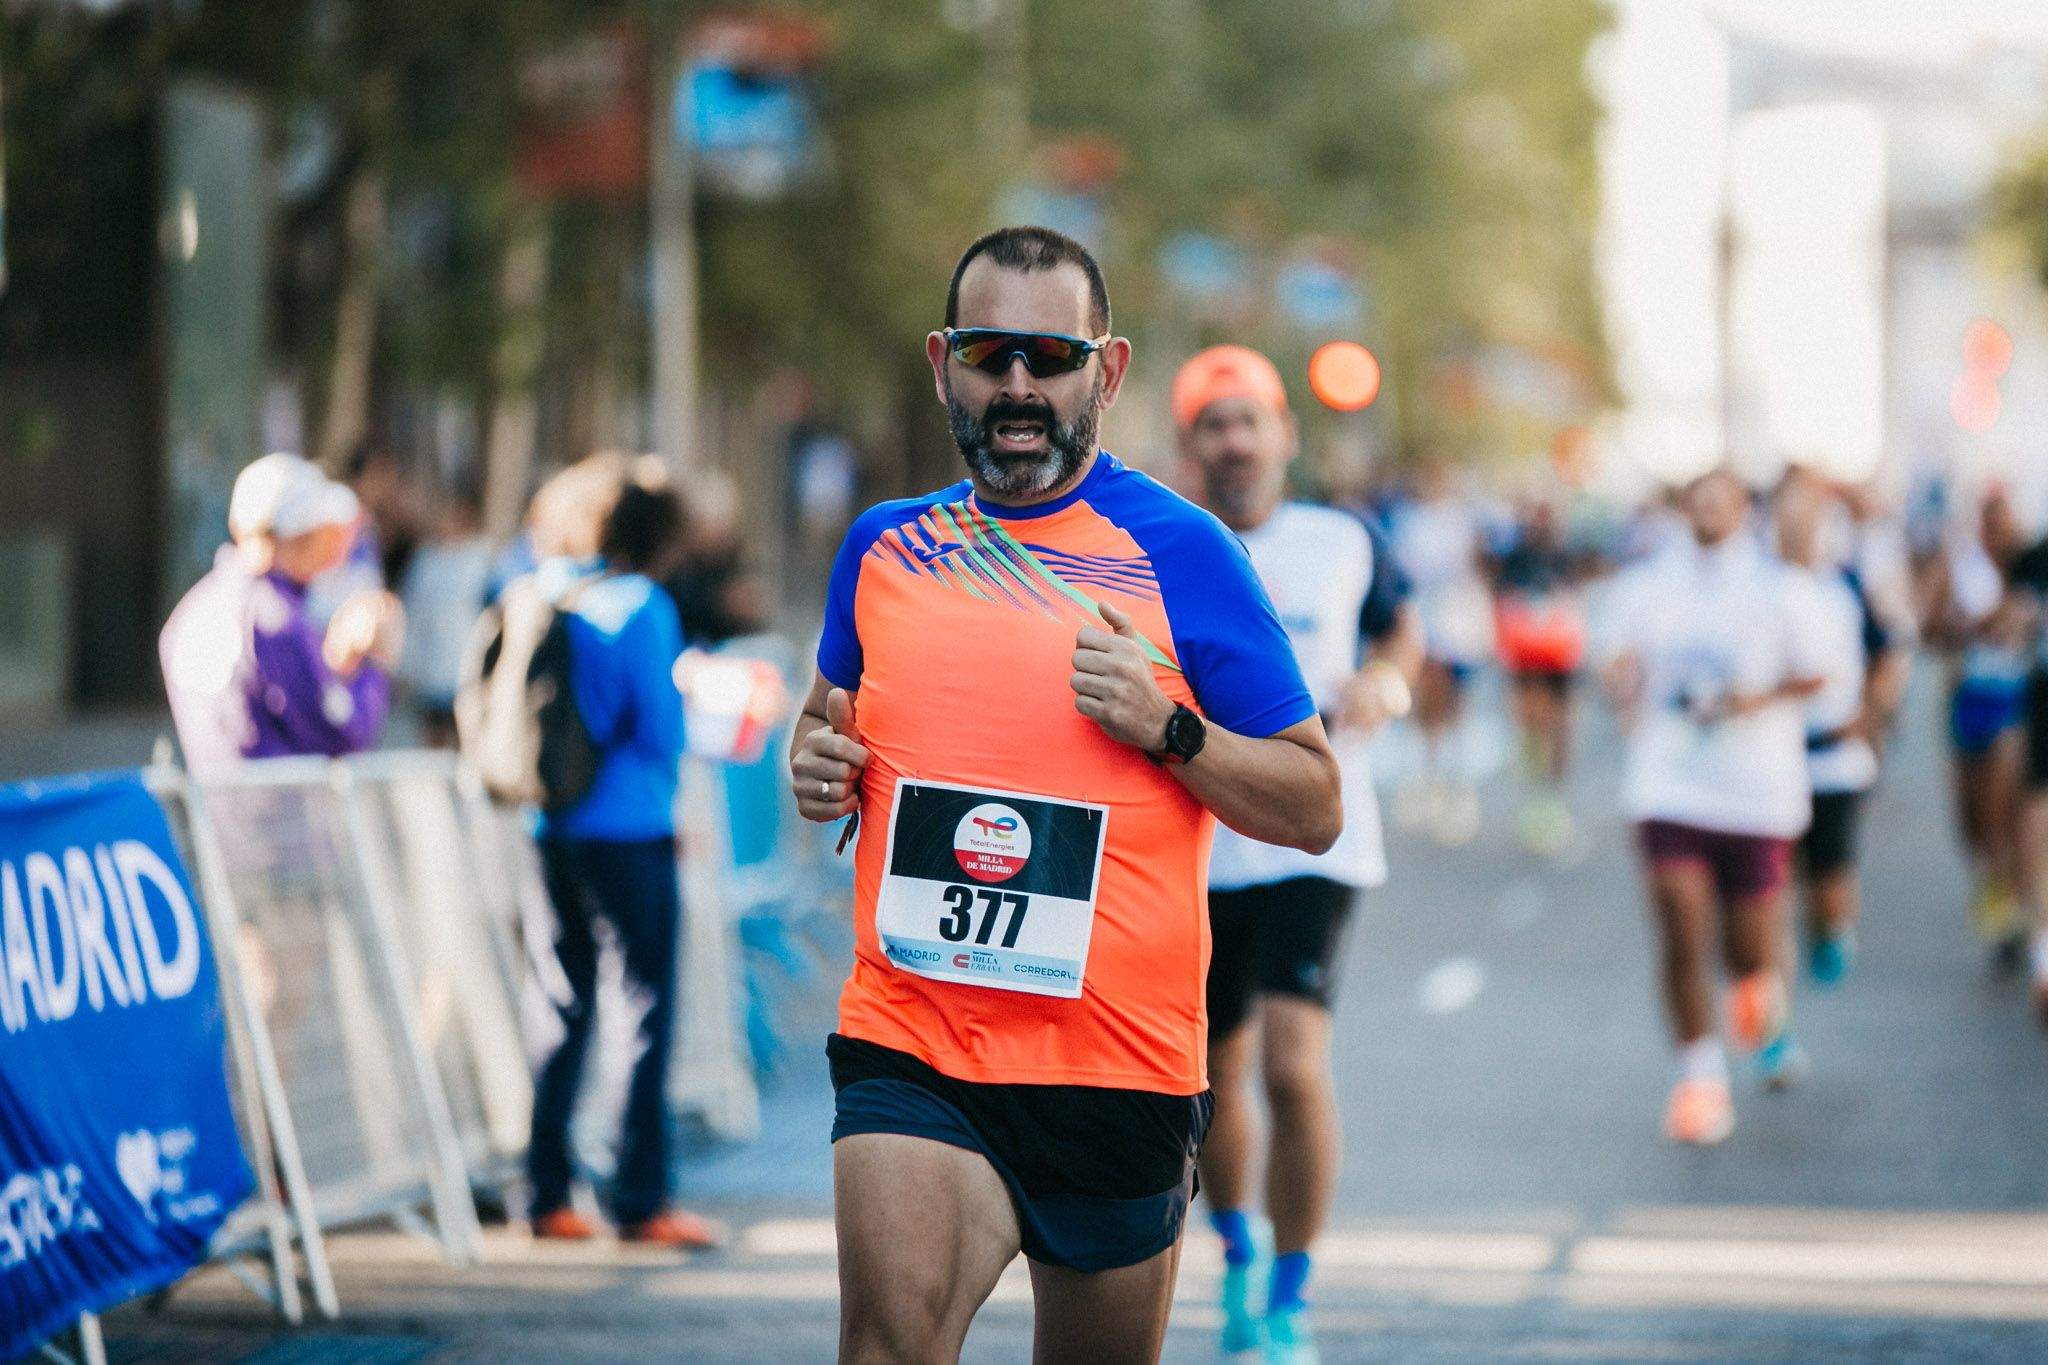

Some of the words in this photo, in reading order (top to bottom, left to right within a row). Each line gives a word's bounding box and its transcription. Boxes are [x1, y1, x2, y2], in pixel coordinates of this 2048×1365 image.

[970, 839, 1015, 851] TotalEnergies
[977, 854, 1004, 865] MILLA
[966, 861, 978, 870] DE
[980, 862, 1013, 874] MADRID
[939, 884, 1030, 949] 377
[899, 947, 941, 962] MADRID
[972, 955, 998, 965] MILLA
